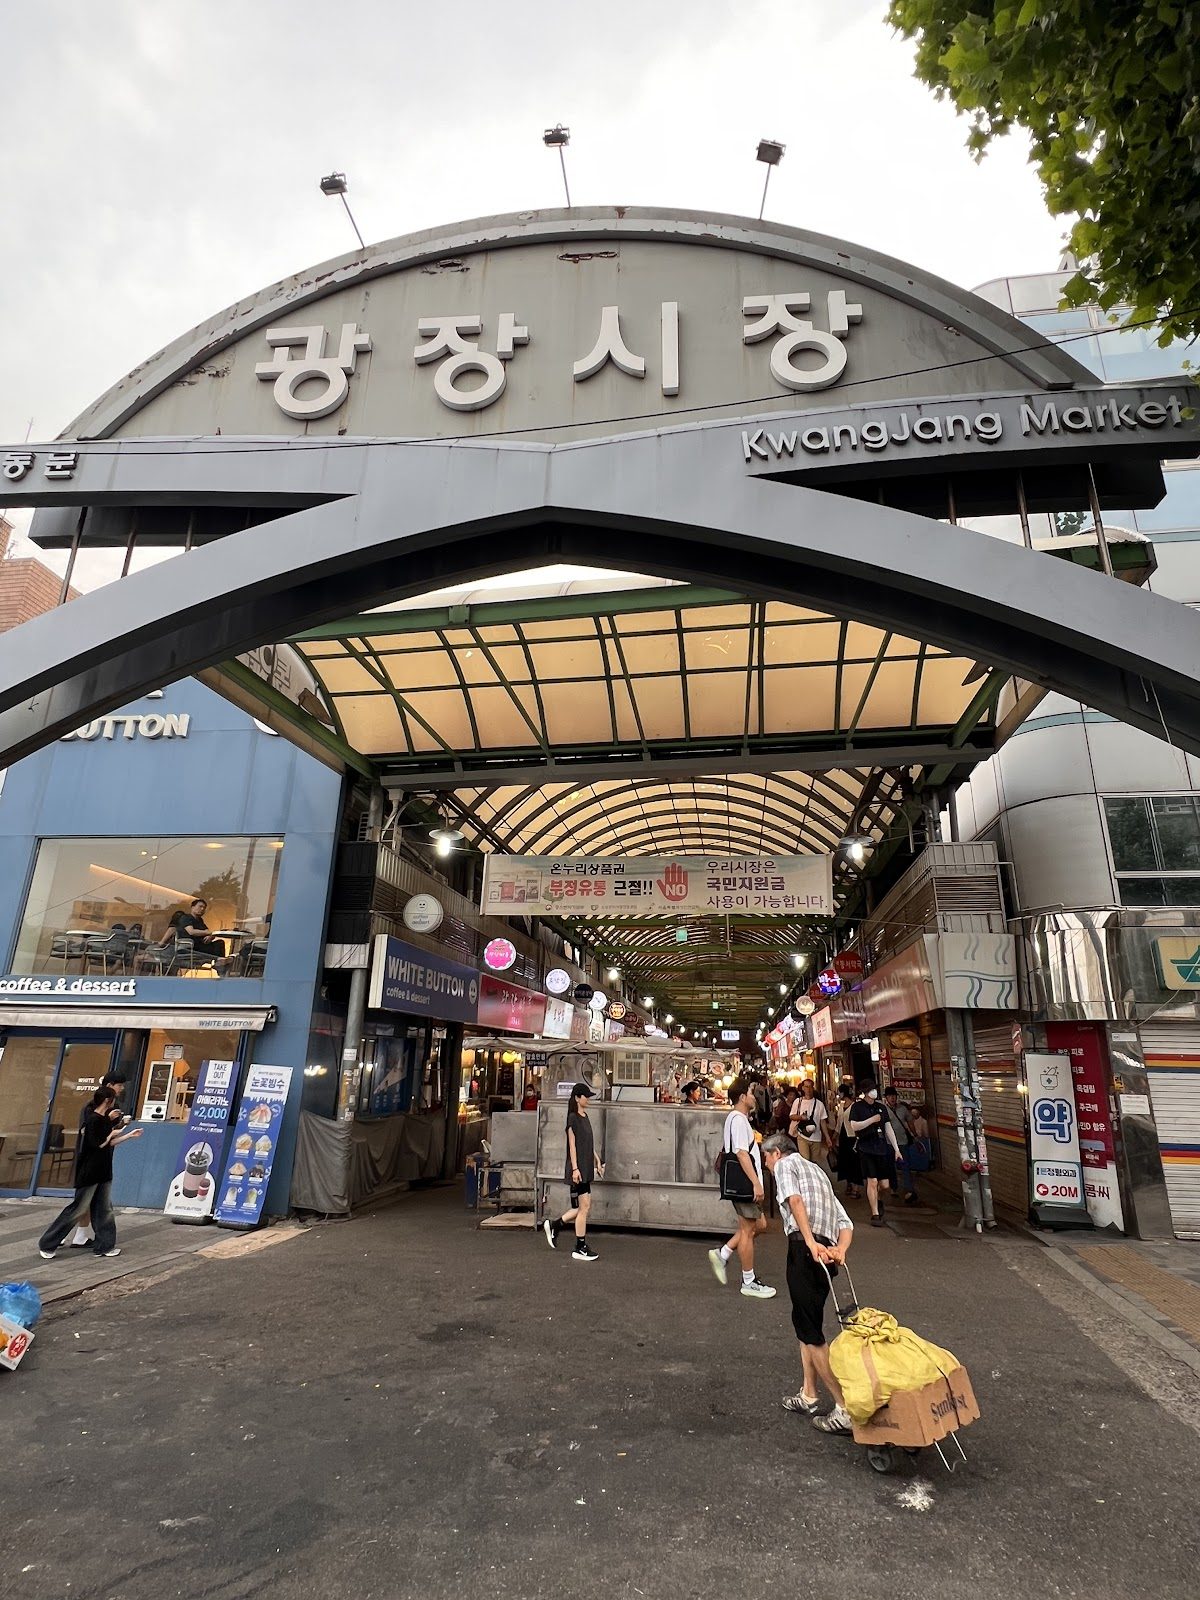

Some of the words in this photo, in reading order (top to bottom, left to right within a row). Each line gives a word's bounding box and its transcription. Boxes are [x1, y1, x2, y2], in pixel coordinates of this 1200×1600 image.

[255, 288, 863, 421] 광장시장
[741, 408, 1004, 463] KwangJang
[1019, 393, 1184, 438] Market
[550, 863, 625, 876] 온누리상품권
[705, 860, 777, 874] 우리시장은
[549, 879, 607, 897] 부정유통
[613, 880, 653, 897] 근절!!
[665, 884, 686, 897] NO
[706, 877, 786, 892] 국민지원금
[706, 896, 749, 909] 사용이
[754, 895, 828, 909] 가능합니다.
[388, 955, 425, 987] WHITE
[425, 968, 465, 998] BUTTON
[54, 978, 67, 992] &
[70, 979, 137, 997] dessert
[386, 986, 405, 1000] coffee
[411, 993, 430, 1005] dessert
[198, 1020, 221, 1028] WHITE
[222, 1020, 254, 1029] BUTTON
[214, 1063, 227, 1071] TAKE
[213, 1071, 224, 1079] OUT
[197, 1094, 229, 1107] 아메리카노
[1035, 1101, 1071, 1140] 약
[1051, 1185, 1079, 1198] 20M
